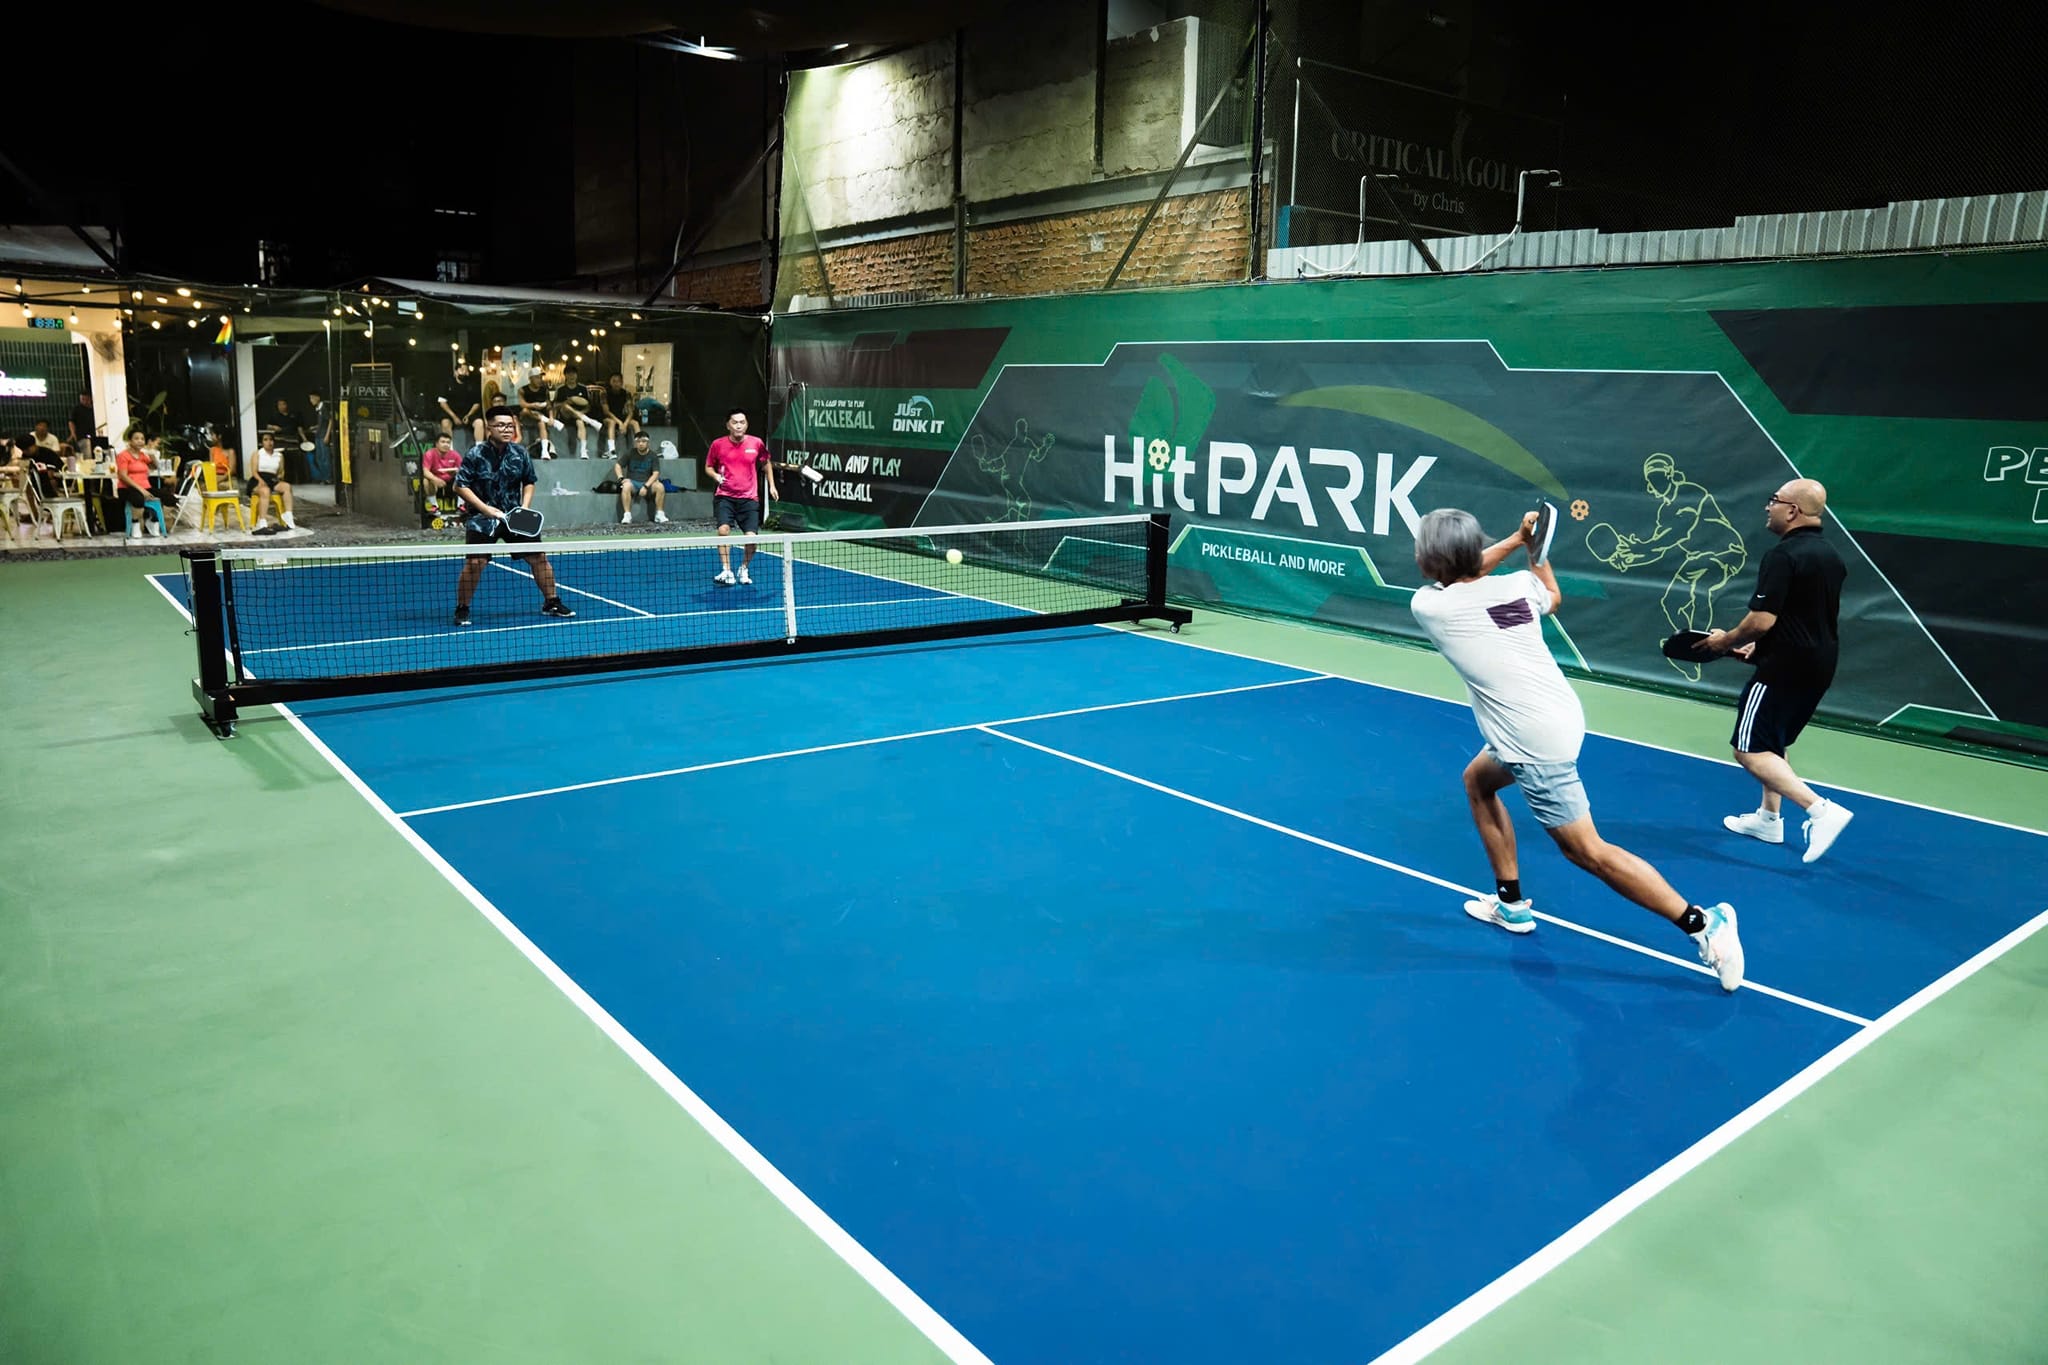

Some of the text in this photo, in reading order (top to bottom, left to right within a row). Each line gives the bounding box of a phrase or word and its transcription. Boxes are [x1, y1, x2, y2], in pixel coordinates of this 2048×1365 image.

[1331, 130, 1450, 181] CRITICAL
[1413, 191, 1465, 214] by Chris
[808, 409, 875, 430] PICKLEBALL
[894, 402, 922, 417] JUST
[892, 418, 945, 434] DINK IT
[812, 452, 843, 473] CALM
[845, 455, 870, 474] AND
[872, 457, 902, 477] PLAY
[811, 480, 873, 503] PICKLEBALL
[1201, 542, 1346, 577] PICKLEBALL AND MORE
